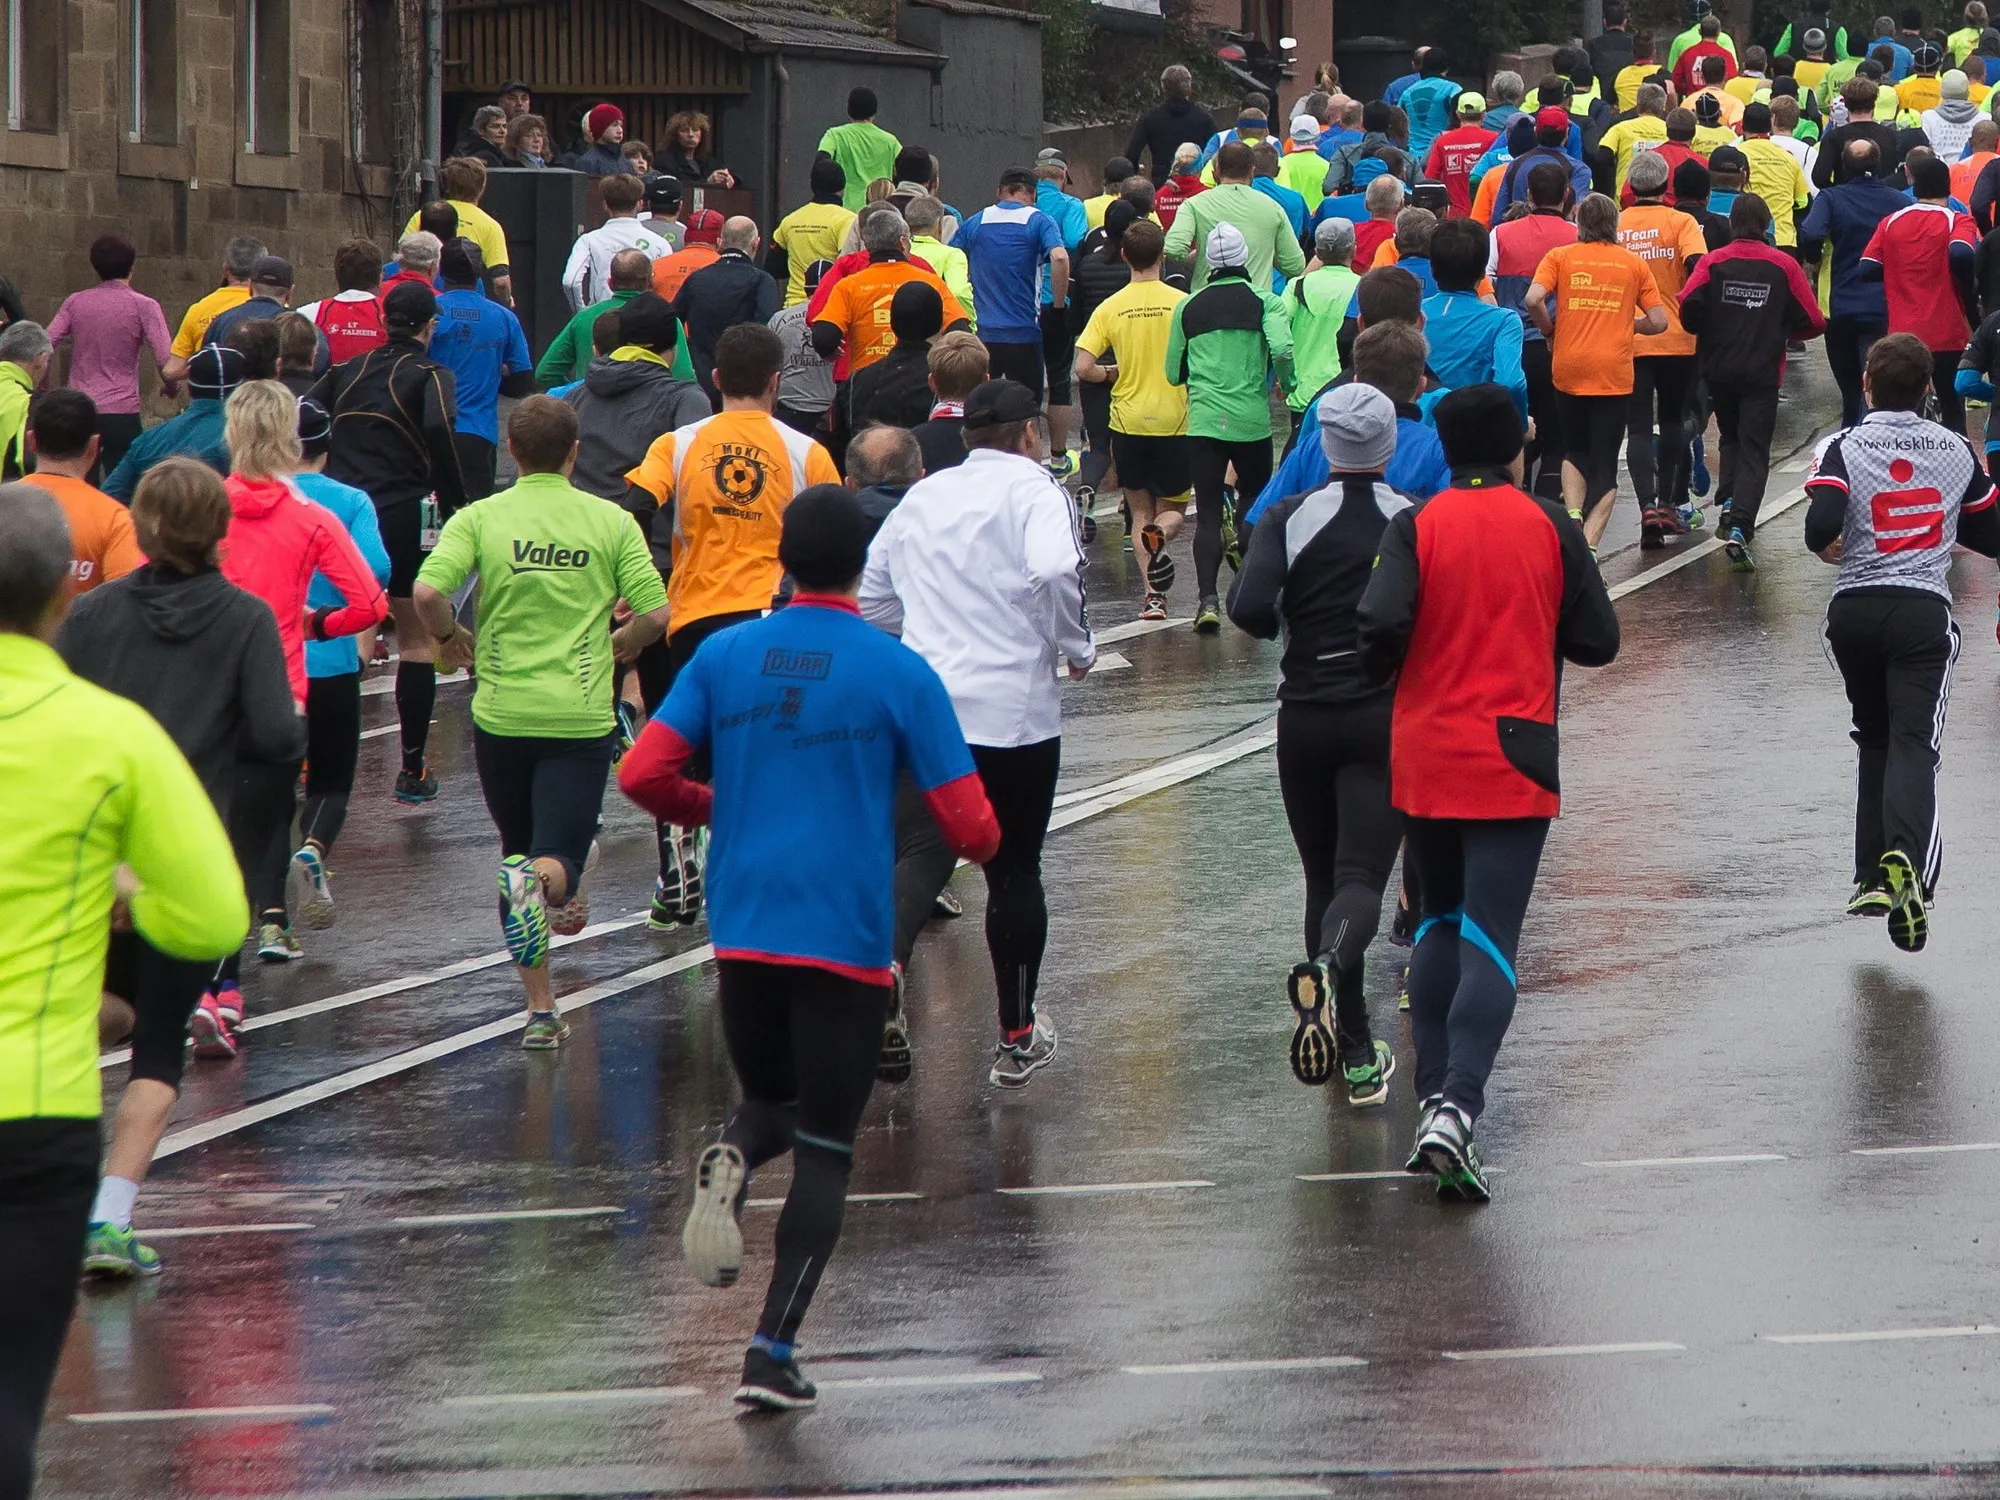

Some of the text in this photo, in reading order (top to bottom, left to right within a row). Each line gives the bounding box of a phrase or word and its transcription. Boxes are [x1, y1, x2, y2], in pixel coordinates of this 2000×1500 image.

[1626, 241, 1653, 250] Fabian
[1635, 247, 1675, 260] mling
[782, 311, 807, 325] Lauf
[342, 329, 377, 337] TALHEIM
[1855, 436, 1956, 452] www.ksklb.de
[513, 540, 590, 568] Valeo
